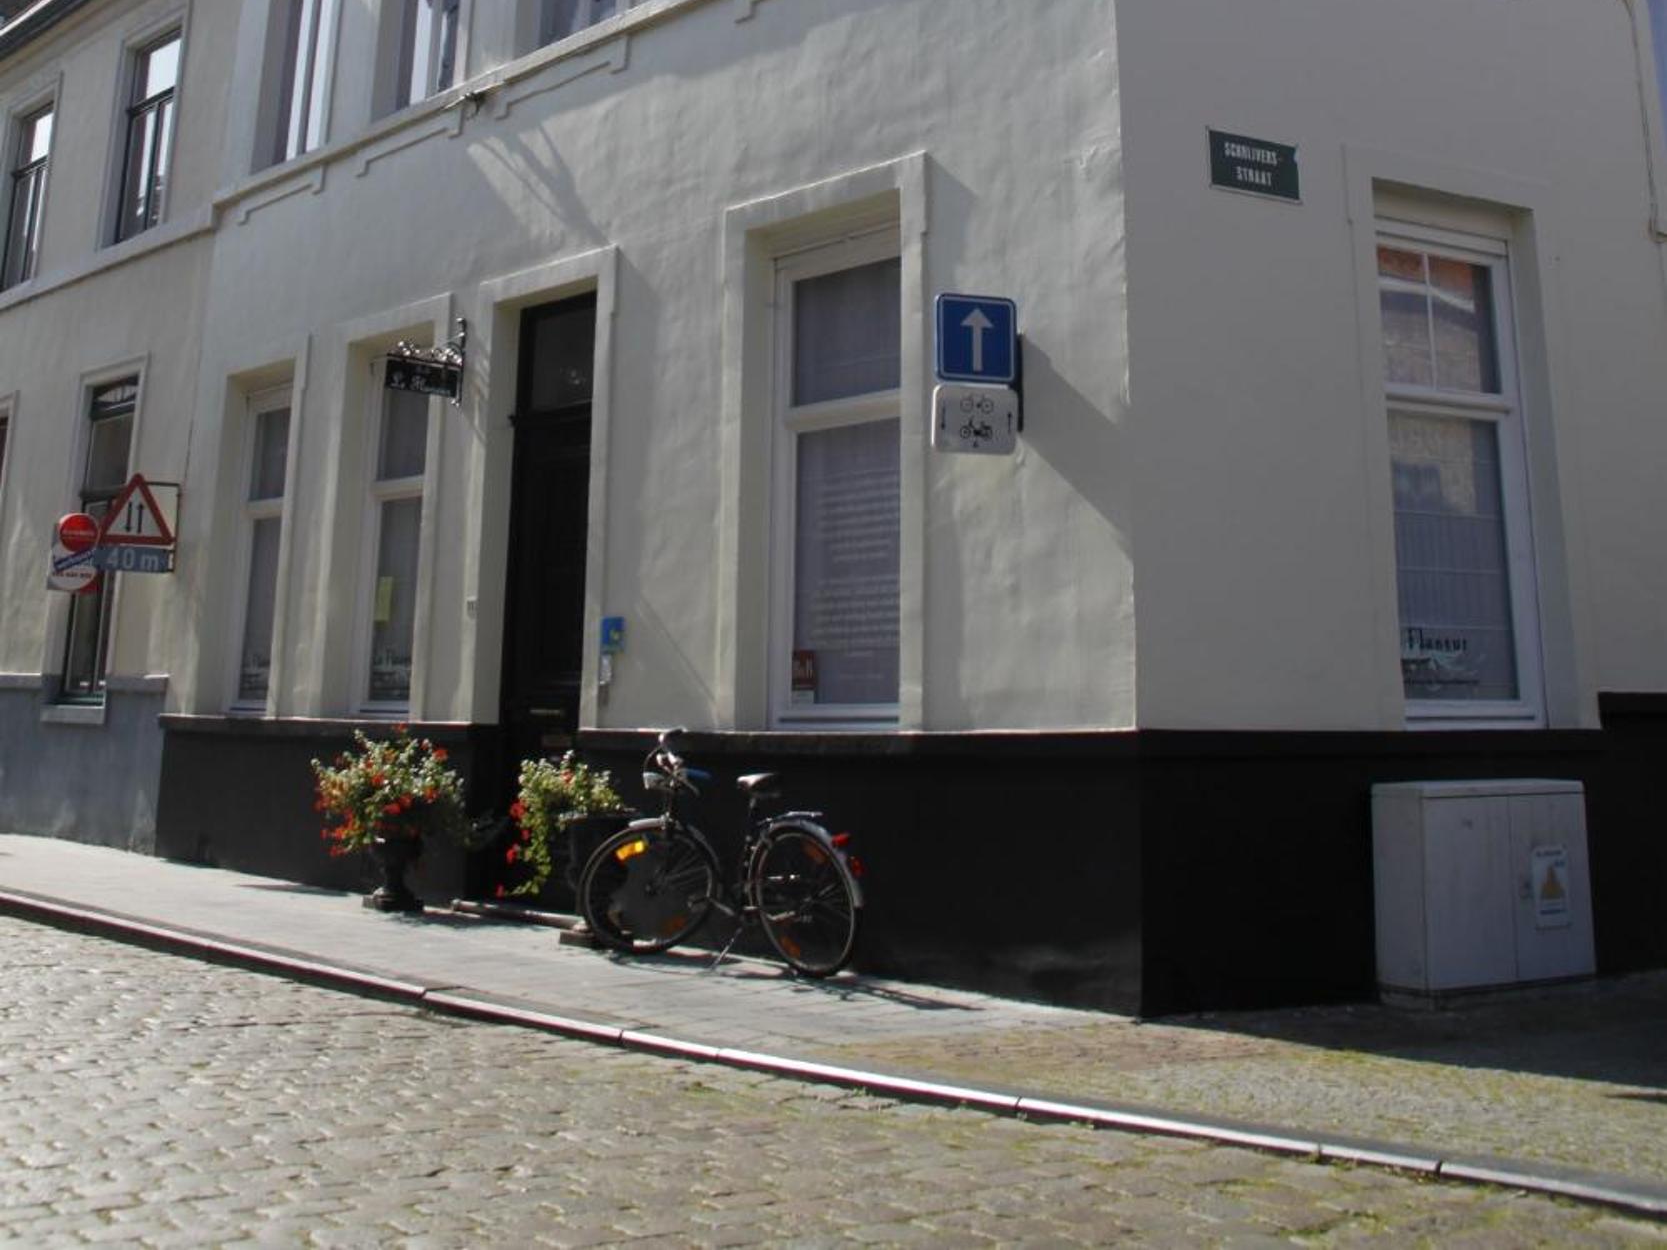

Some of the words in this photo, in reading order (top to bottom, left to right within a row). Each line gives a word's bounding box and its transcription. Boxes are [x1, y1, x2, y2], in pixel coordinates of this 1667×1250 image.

[1236, 166, 1272, 187] STRAAT
[106, 548, 136, 569] 40
[140, 555, 159, 570] m
